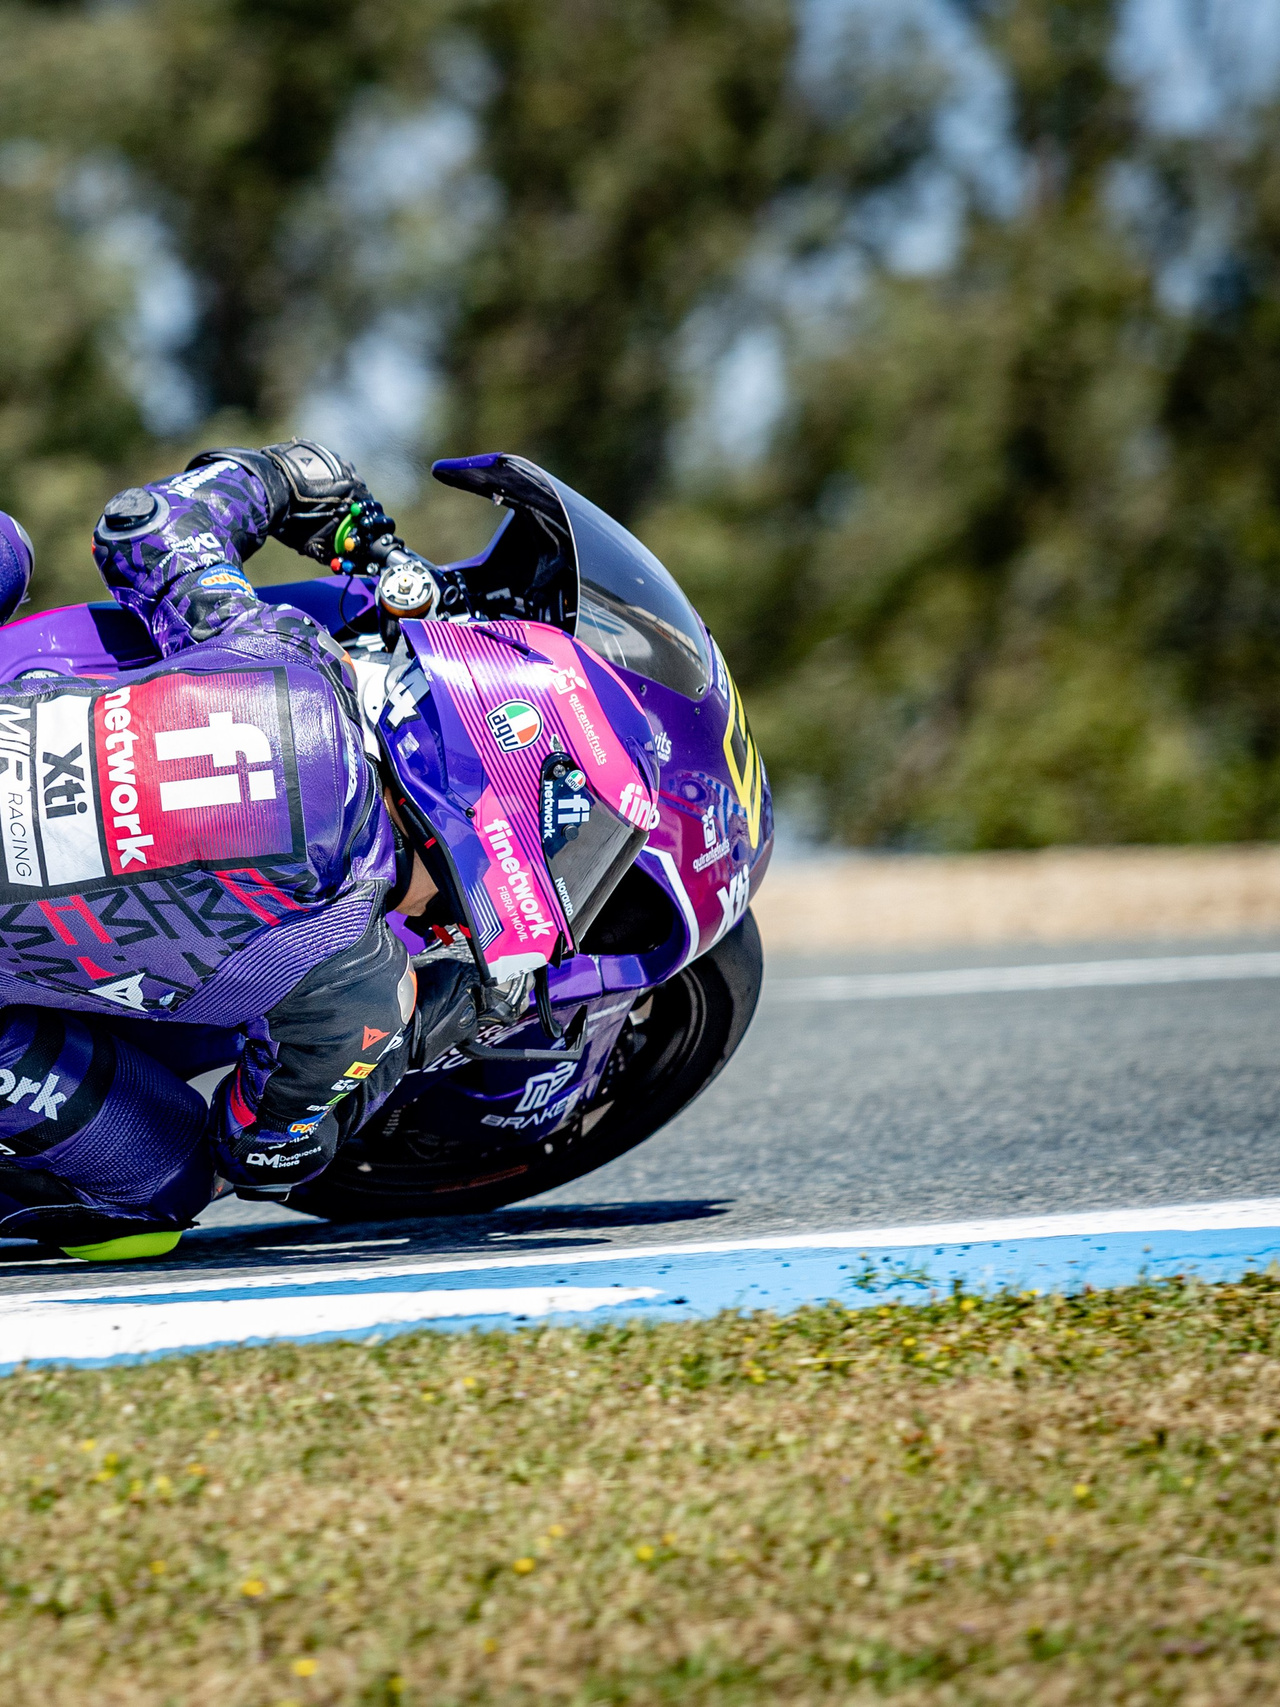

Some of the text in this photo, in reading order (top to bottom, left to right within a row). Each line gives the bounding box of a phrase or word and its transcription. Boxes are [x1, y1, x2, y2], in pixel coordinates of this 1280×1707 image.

[154, 711, 277, 812] fi
[569, 693, 608, 765] quirantefruits
[43, 743, 87, 820] Xti
[104, 686, 154, 869] network
[543, 780, 556, 839] network
[8, 791, 32, 878] RACING
[483, 818, 554, 939] finetwork
[497, 886, 515, 912] FIBRA
[512, 916, 528, 942] MÓVIL
[555, 877, 574, 917] Norauto
[246, 1153, 280, 1168] DM
